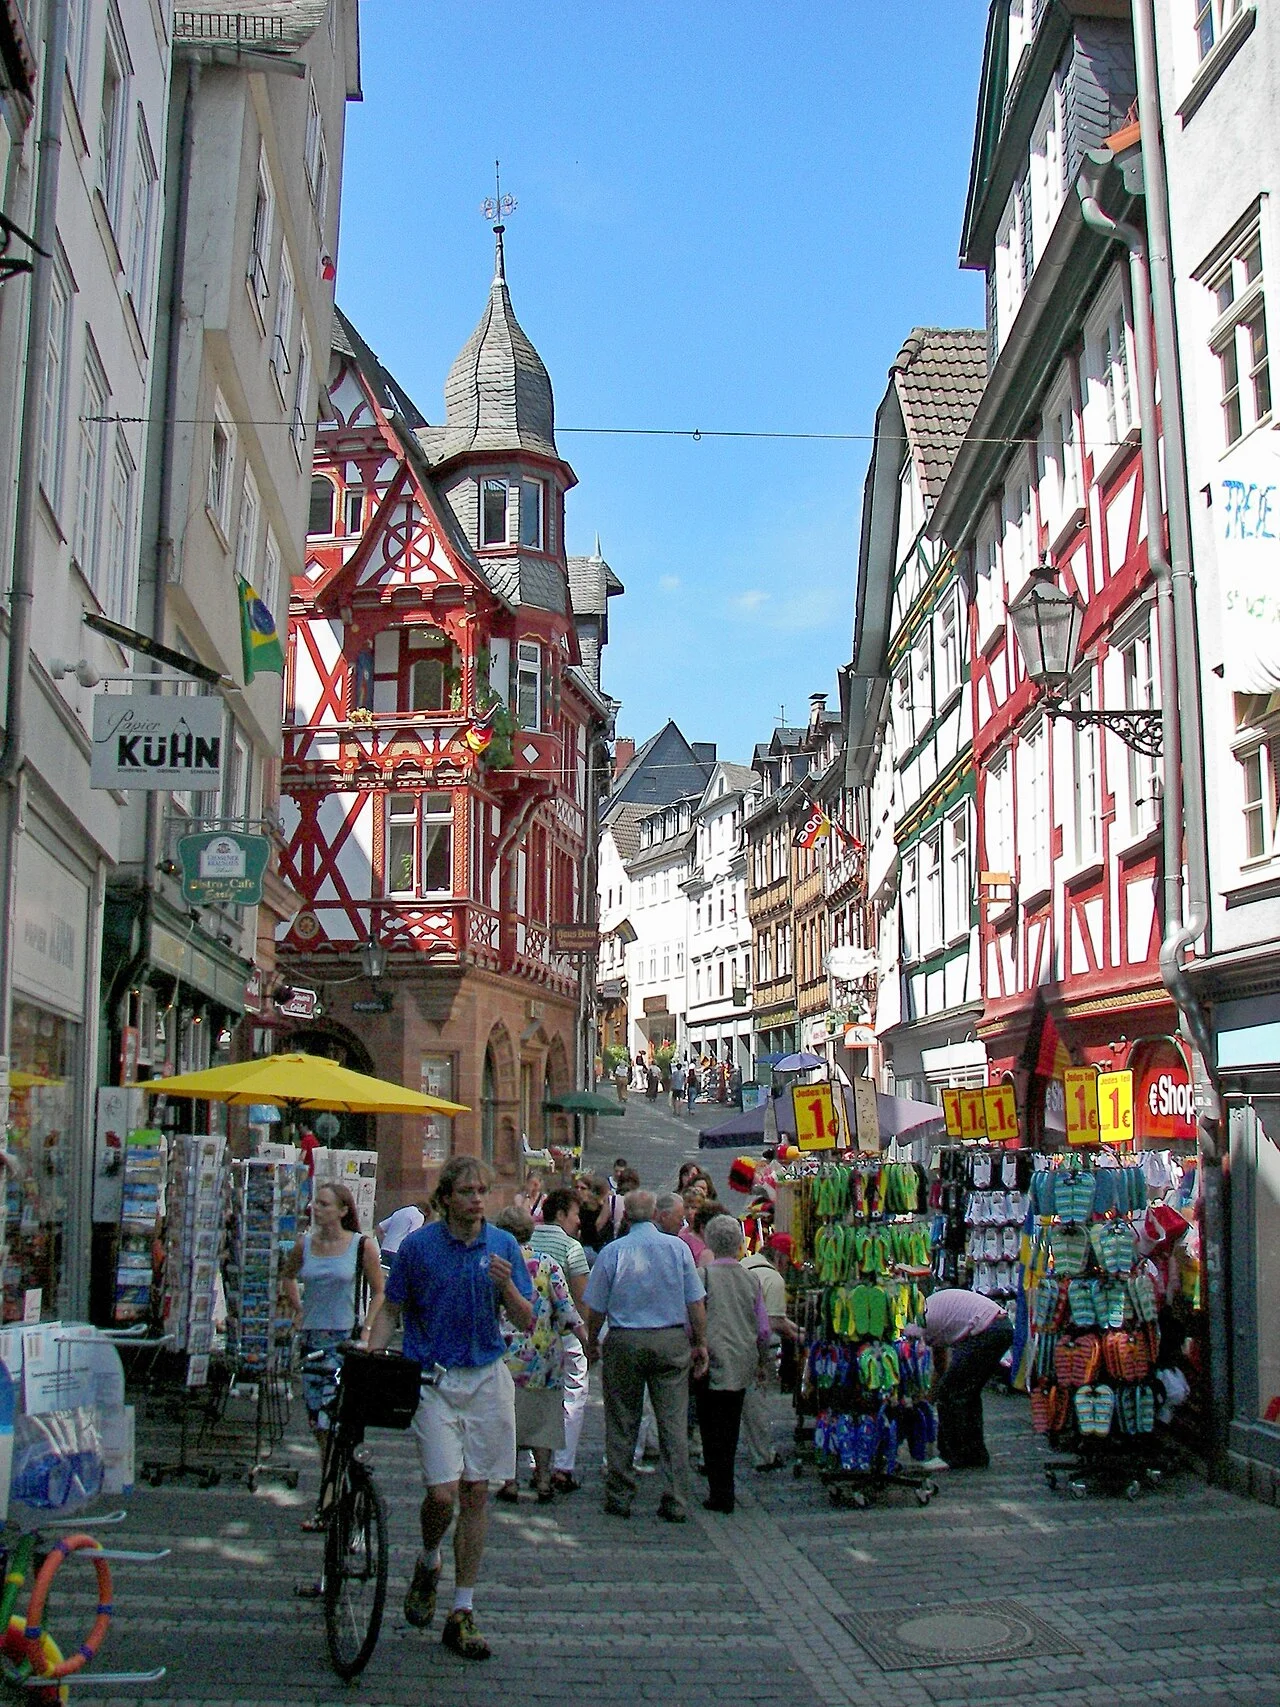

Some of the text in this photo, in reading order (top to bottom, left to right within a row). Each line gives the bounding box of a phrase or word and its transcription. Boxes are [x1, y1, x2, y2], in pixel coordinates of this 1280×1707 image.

[95, 710, 160, 743] Papier
[117, 733, 220, 768] KÜHN
[1066, 1072, 1084, 1082] Jedes
[1100, 1074, 1131, 1085] Jedes Teil
[967, 1100, 977, 1131] 1
[993, 1097, 1007, 1131] 1
[1007, 1113, 1016, 1129] €
[1075, 1085, 1087, 1130] 1
[1088, 1110, 1097, 1129] €
[1109, 1087, 1119, 1128] 1
[1121, 1109, 1131, 1128] €
[1149, 1074, 1196, 1124] €Shop
[808, 1099, 825, 1138] 1
